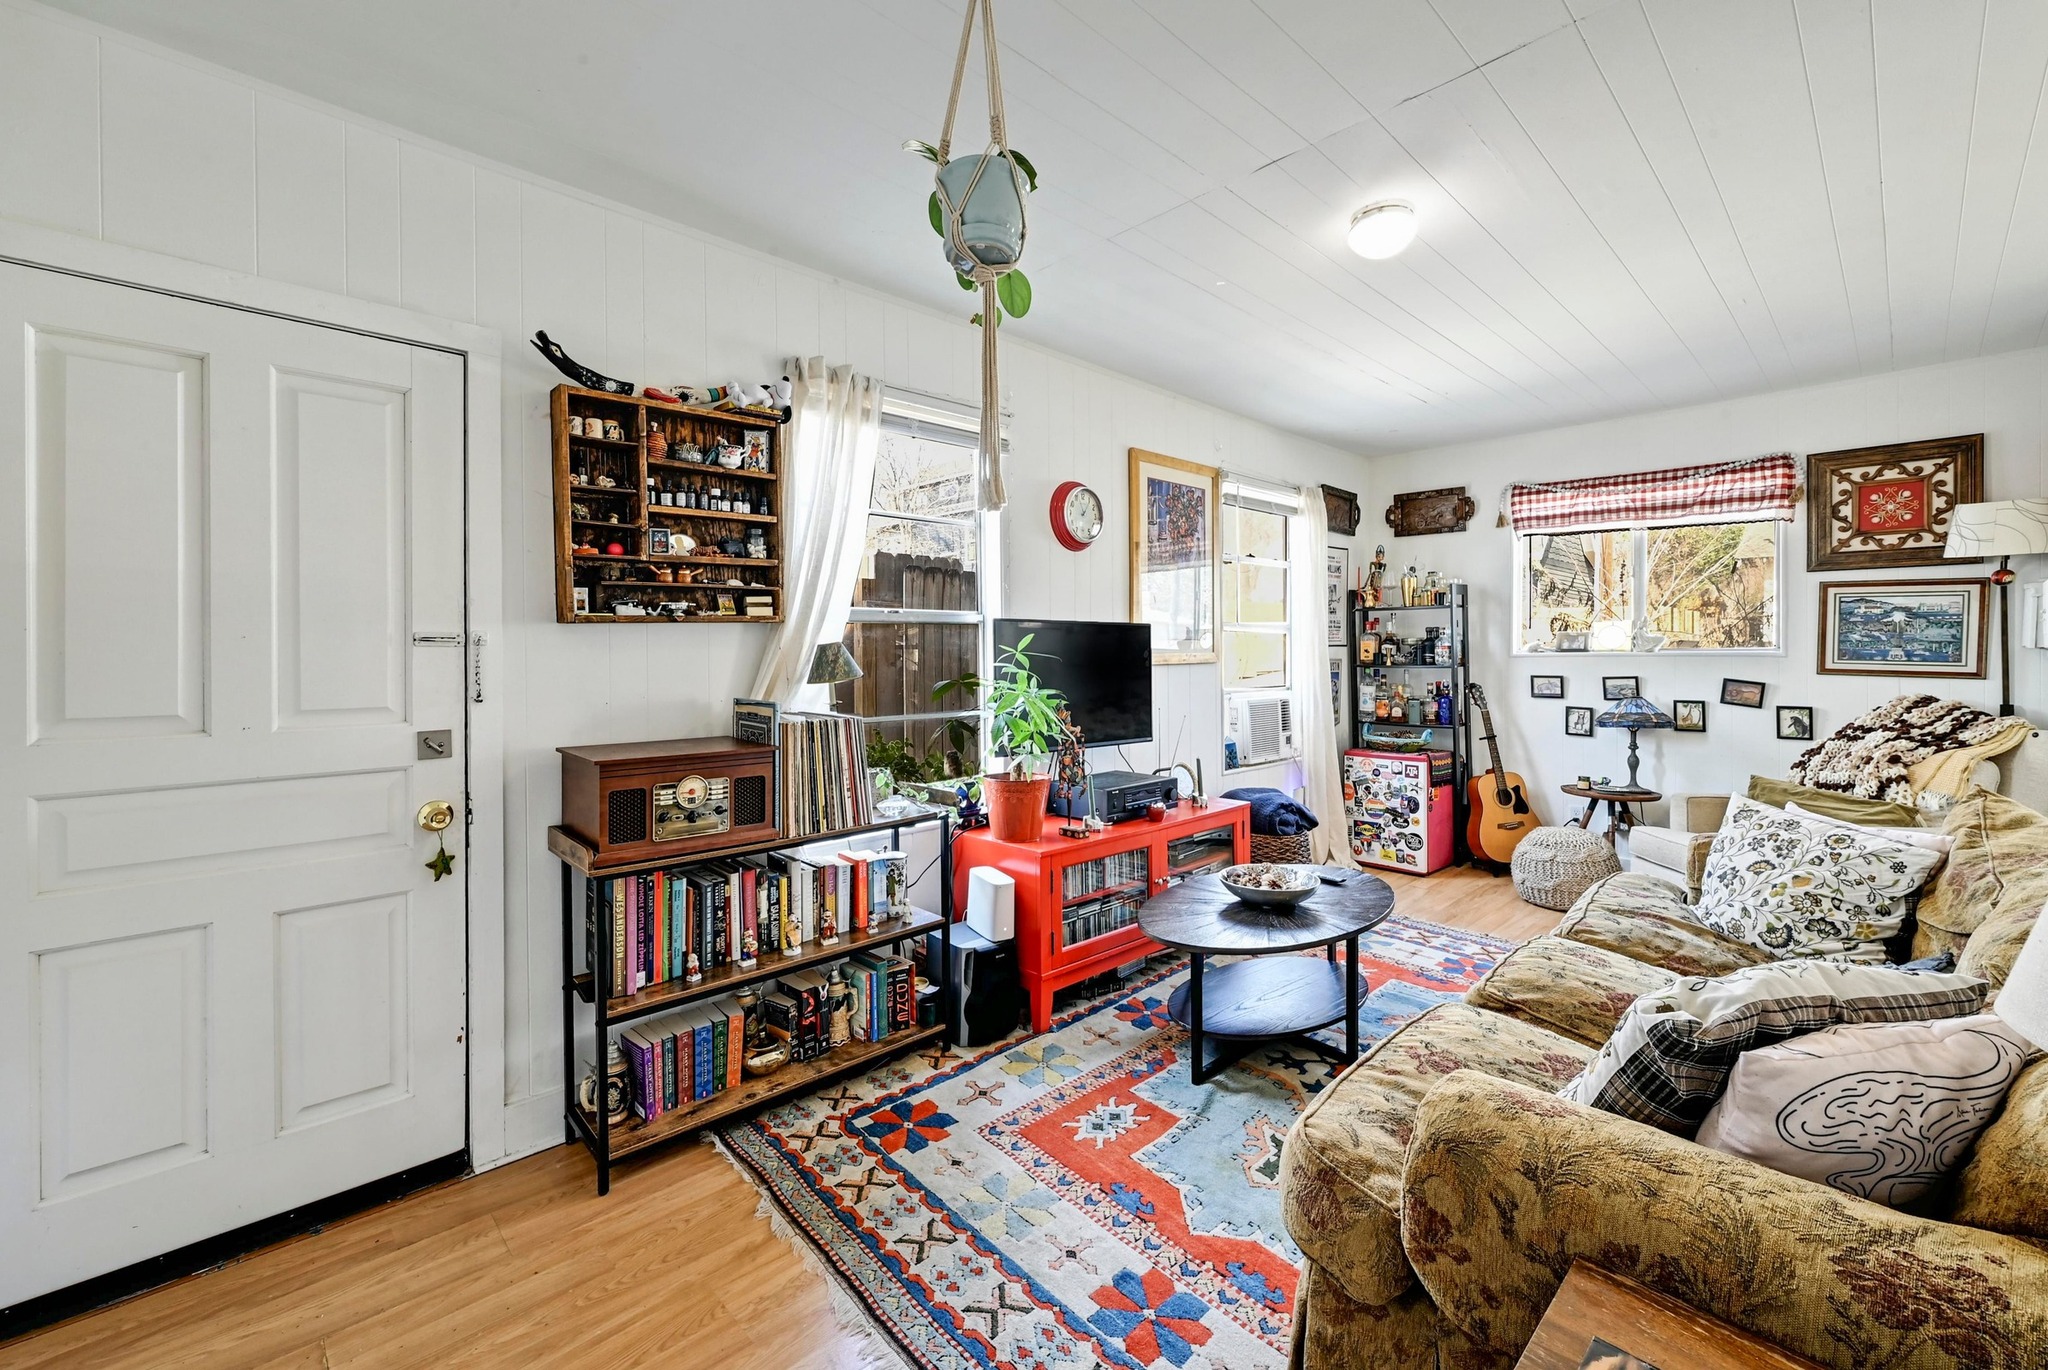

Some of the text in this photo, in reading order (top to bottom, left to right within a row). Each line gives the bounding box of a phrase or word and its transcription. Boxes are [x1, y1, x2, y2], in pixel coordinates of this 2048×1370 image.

[615, 893, 624, 912] WES
[615, 914, 624, 959] ANDERSON
[770, 921, 779, 941] ASIMOV
[896, 983, 909, 1022] DUNE
